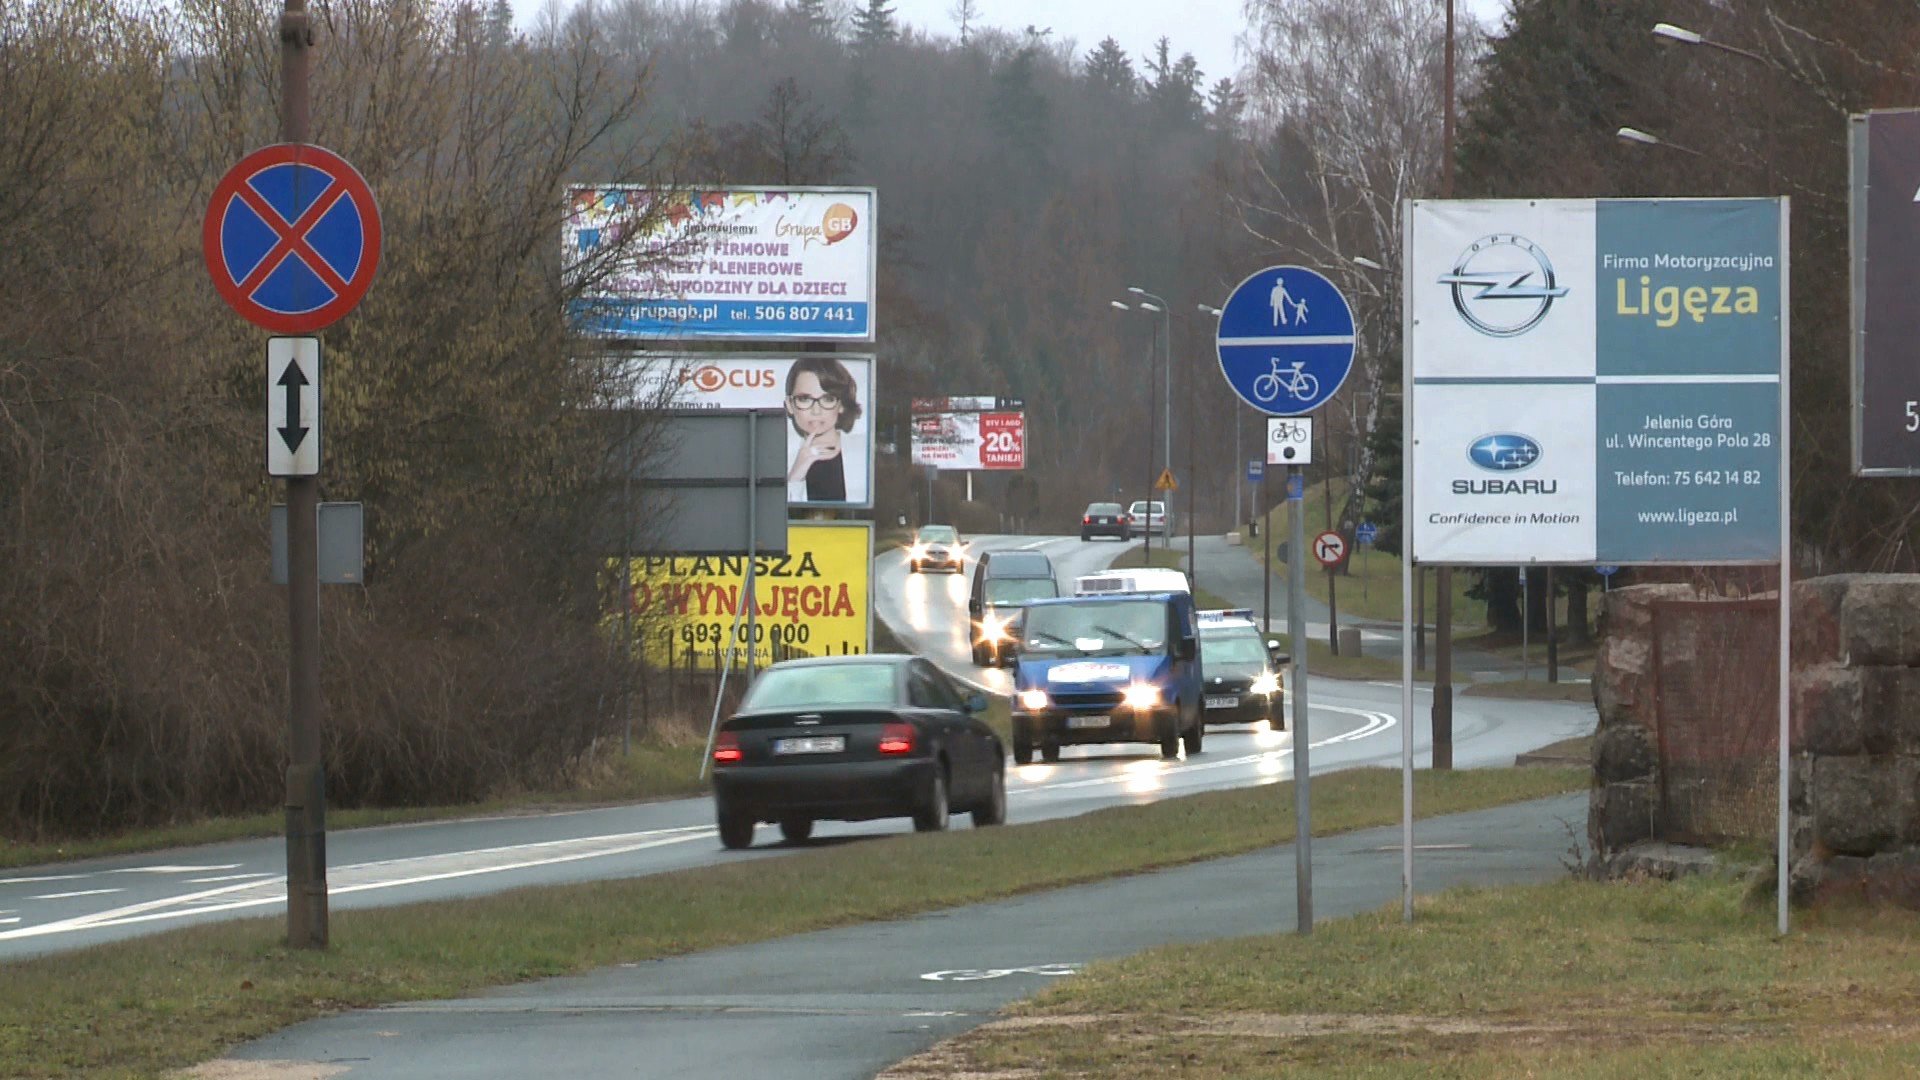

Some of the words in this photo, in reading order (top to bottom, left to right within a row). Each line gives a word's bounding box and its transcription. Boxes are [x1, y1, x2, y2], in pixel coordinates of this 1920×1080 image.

[775, 214, 823, 251] Grupa
[828, 217, 853, 232] GB
[713, 242, 789, 256] FIRMOWE
[1472, 235, 1534, 252] OPEL
[709, 261, 803, 276] PLENEROWE
[1603, 254, 1649, 269] Firma
[1654, 253, 1774, 272] Motoryzacyjna
[671, 280, 753, 295] URODZINY
[758, 281, 788, 295] DLA
[793, 281, 847, 296] DZIECI
[1616, 275, 1759, 327] Ligęza
[730, 308, 751, 320] tel.
[755, 306, 785, 321] 506
[790, 306, 820, 321] 807
[824, 306, 855, 321] 441
[1643, 414, 1694, 430] Jelenia
[1697, 414, 1733, 429] Góra
[986, 431, 1021, 453] 20%
[1606, 434, 1625, 449] ul.
[1628, 433, 1713, 451] Wincentego
[1717, 433, 1750, 448] Pola
[1753, 433, 1771, 448] 28
[1614, 471, 1671, 486] Telefon:
[1674, 471, 1691, 486] 75
[1695, 471, 1721, 486] 642
[1724, 470, 1740, 486] 14
[1743, 470, 1761, 485] 82
[1452, 480, 1557, 495] SUBARU
[1428, 512, 1511, 524] Confidence
[1514, 513, 1526, 525] in
[1530, 512, 1580, 525] Motion
[1638, 508, 1738, 526] www.ligeza.pl
[662, 582, 856, 624] WYNAJĘCIA
[682, 623, 722, 643] 693
